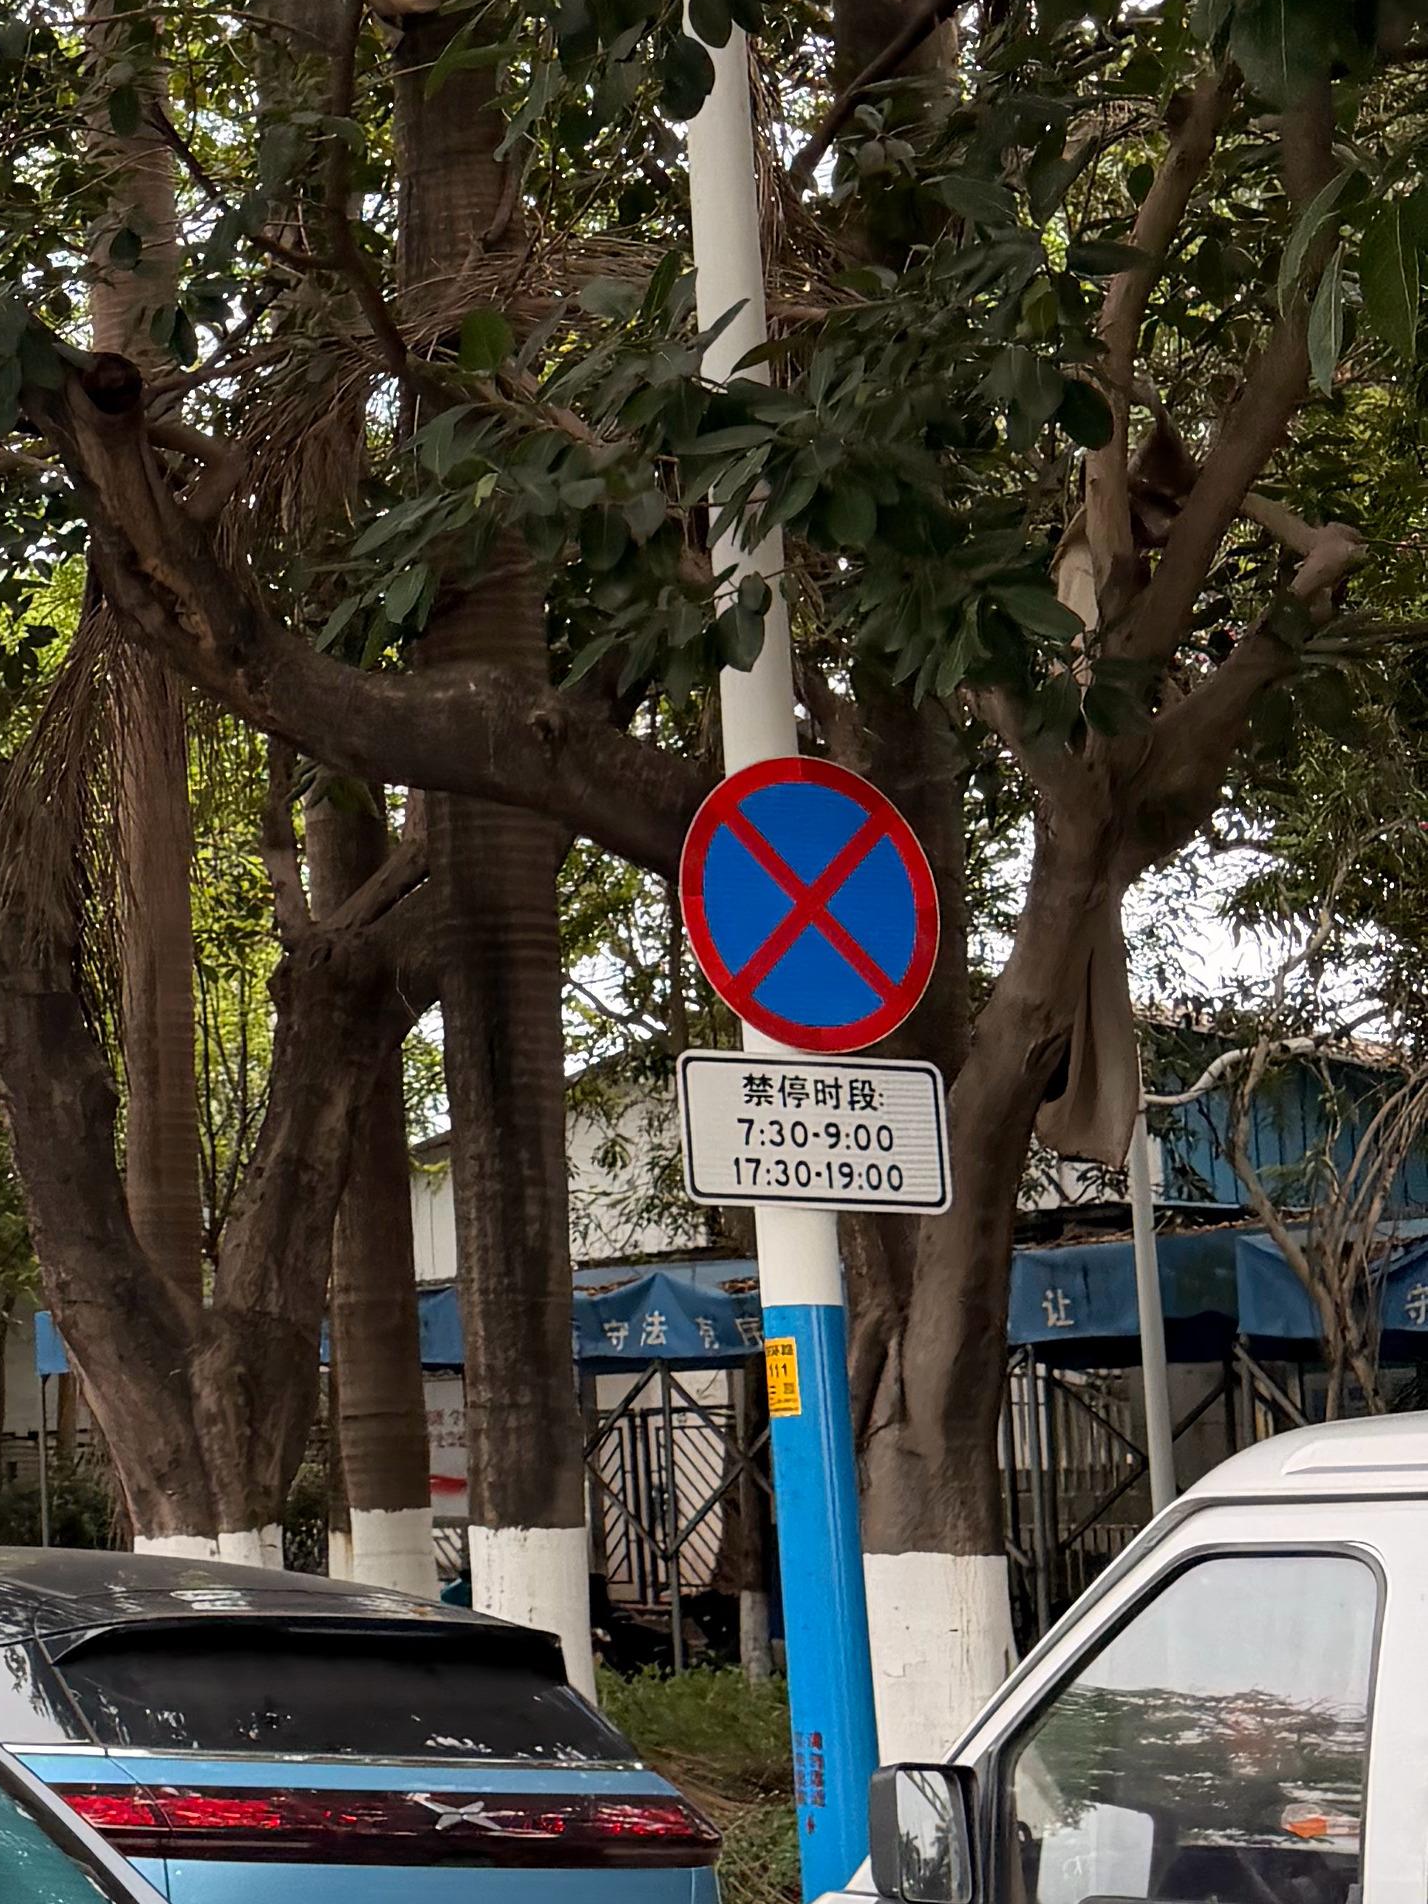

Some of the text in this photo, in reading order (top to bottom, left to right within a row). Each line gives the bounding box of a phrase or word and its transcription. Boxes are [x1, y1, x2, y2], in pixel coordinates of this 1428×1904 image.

[742, 1073, 885, 1112] 禁停时段:
[736, 1117, 894, 1152] 7:30-9:00
[733, 1156, 904, 1192] 17:30-19:00
[1041, 1288, 1075, 1329] 让
